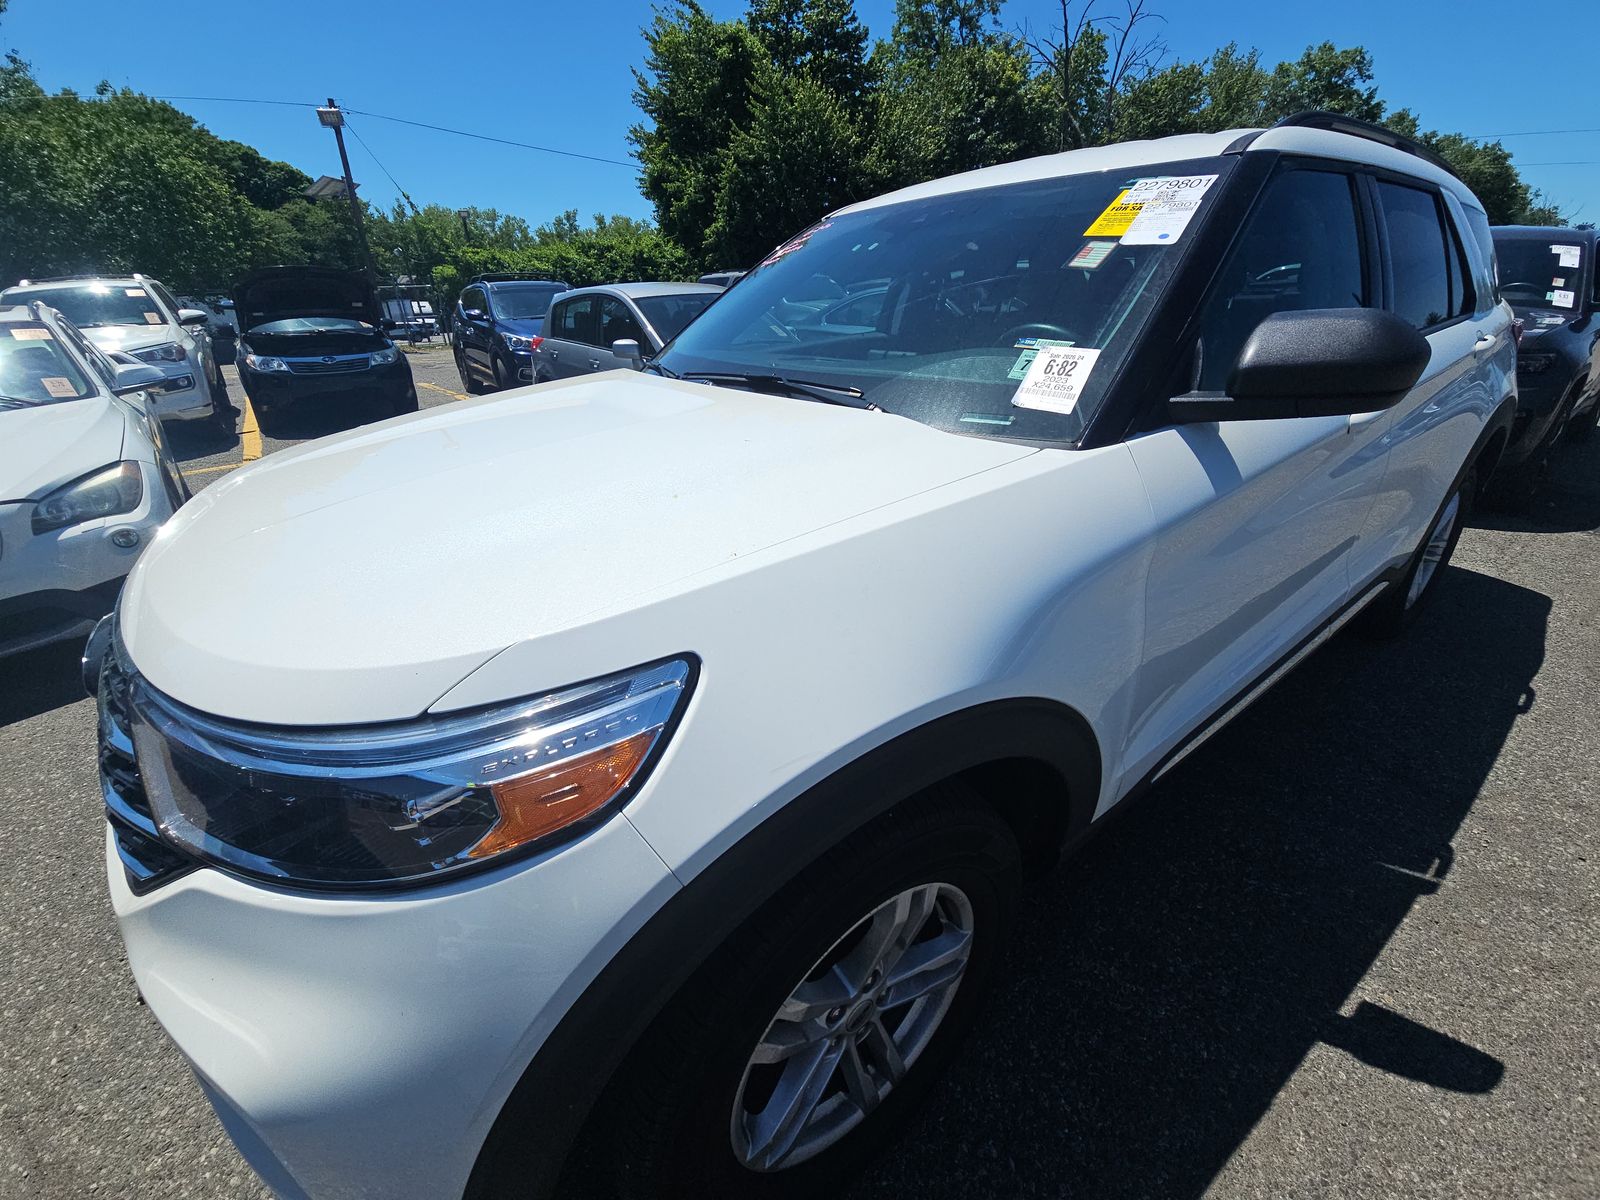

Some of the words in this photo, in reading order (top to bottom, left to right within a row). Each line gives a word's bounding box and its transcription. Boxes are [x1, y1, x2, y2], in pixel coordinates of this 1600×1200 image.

[1133, 178, 1213, 191] 2279801
[1044, 359, 1078, 377] 6:82
[1043, 376, 1069, 384] 2023
